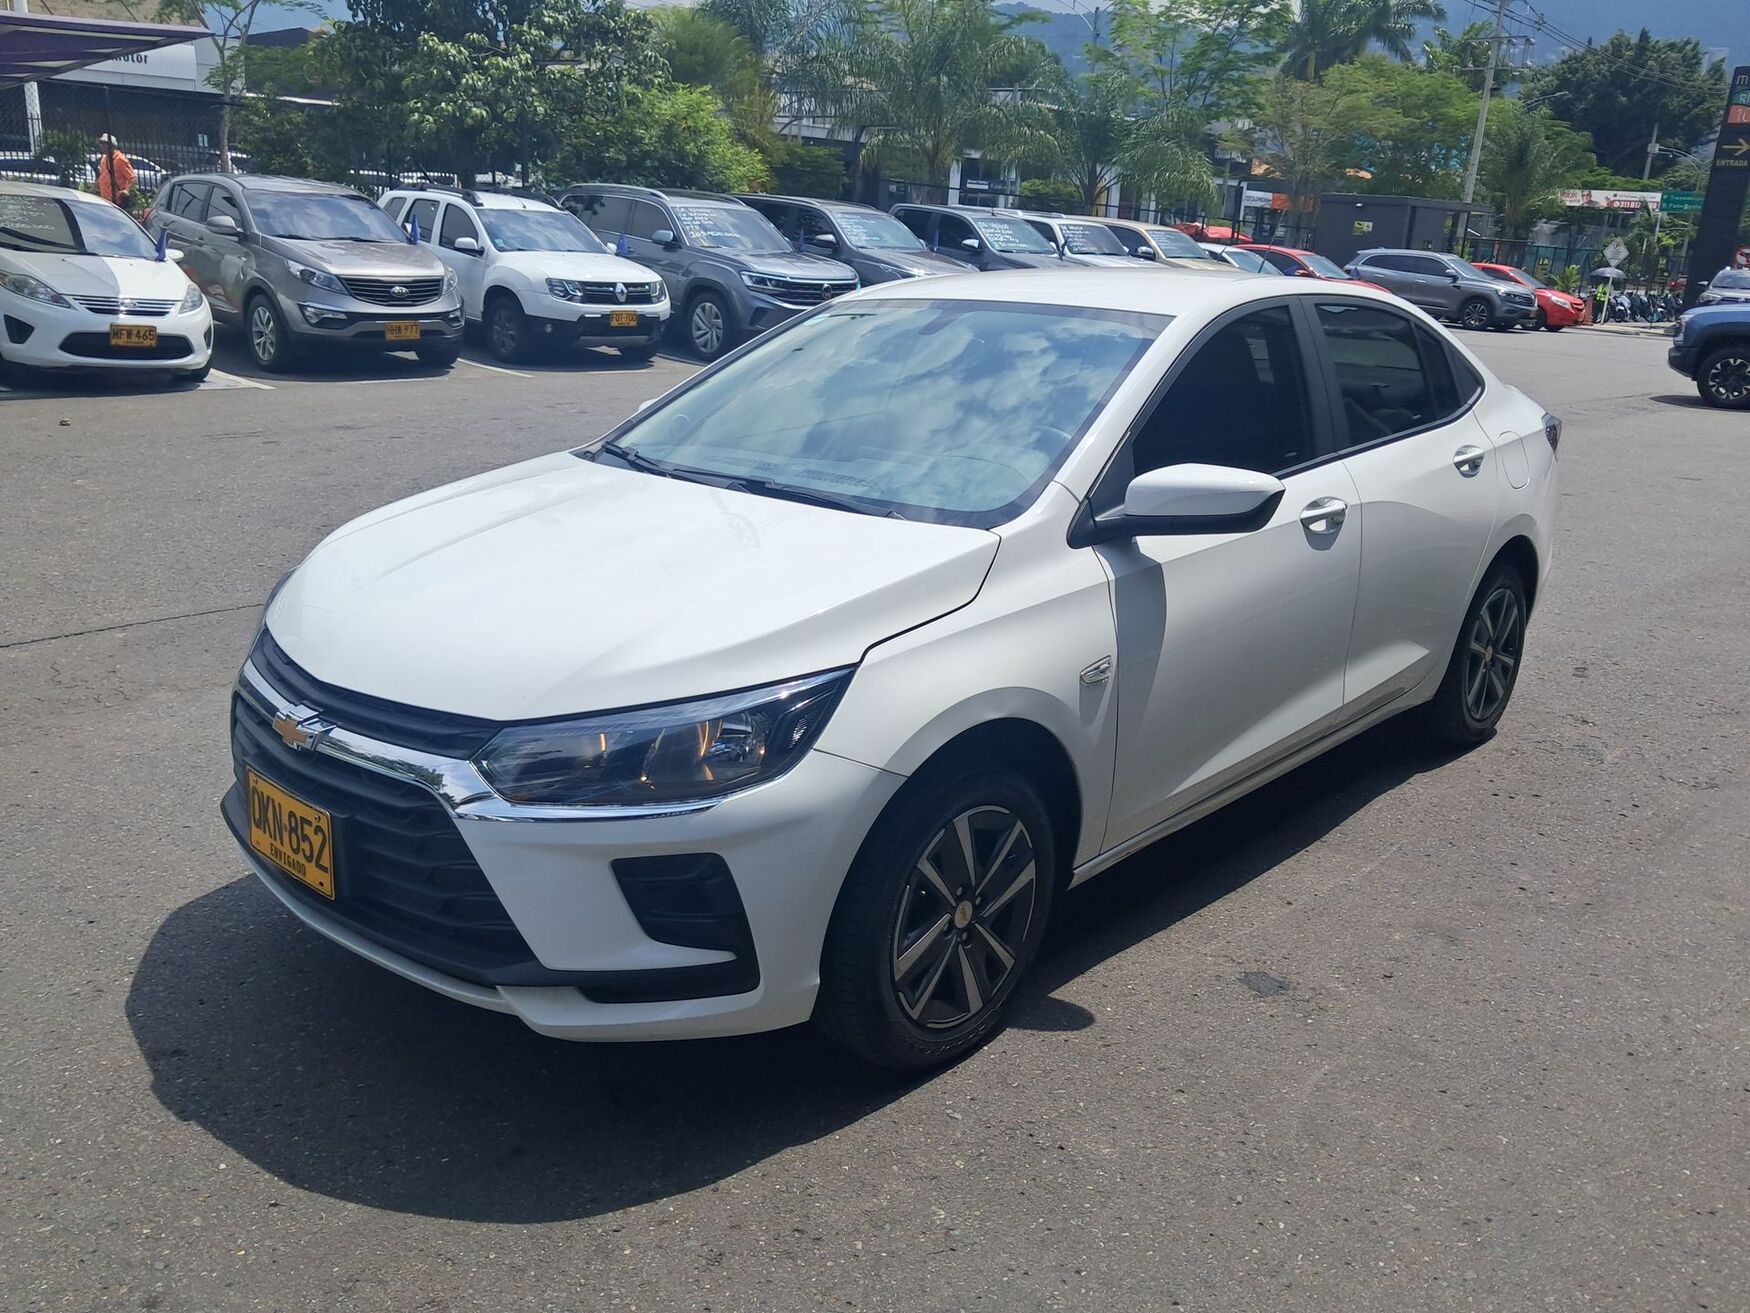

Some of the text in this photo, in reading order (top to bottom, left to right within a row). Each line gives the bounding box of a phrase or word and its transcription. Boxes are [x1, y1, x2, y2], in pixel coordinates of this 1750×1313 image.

[1716, 159, 1748, 167] ENTRADA
[135, 329, 155, 341] 465
[270, 842, 307, 877] ENVIGADO
